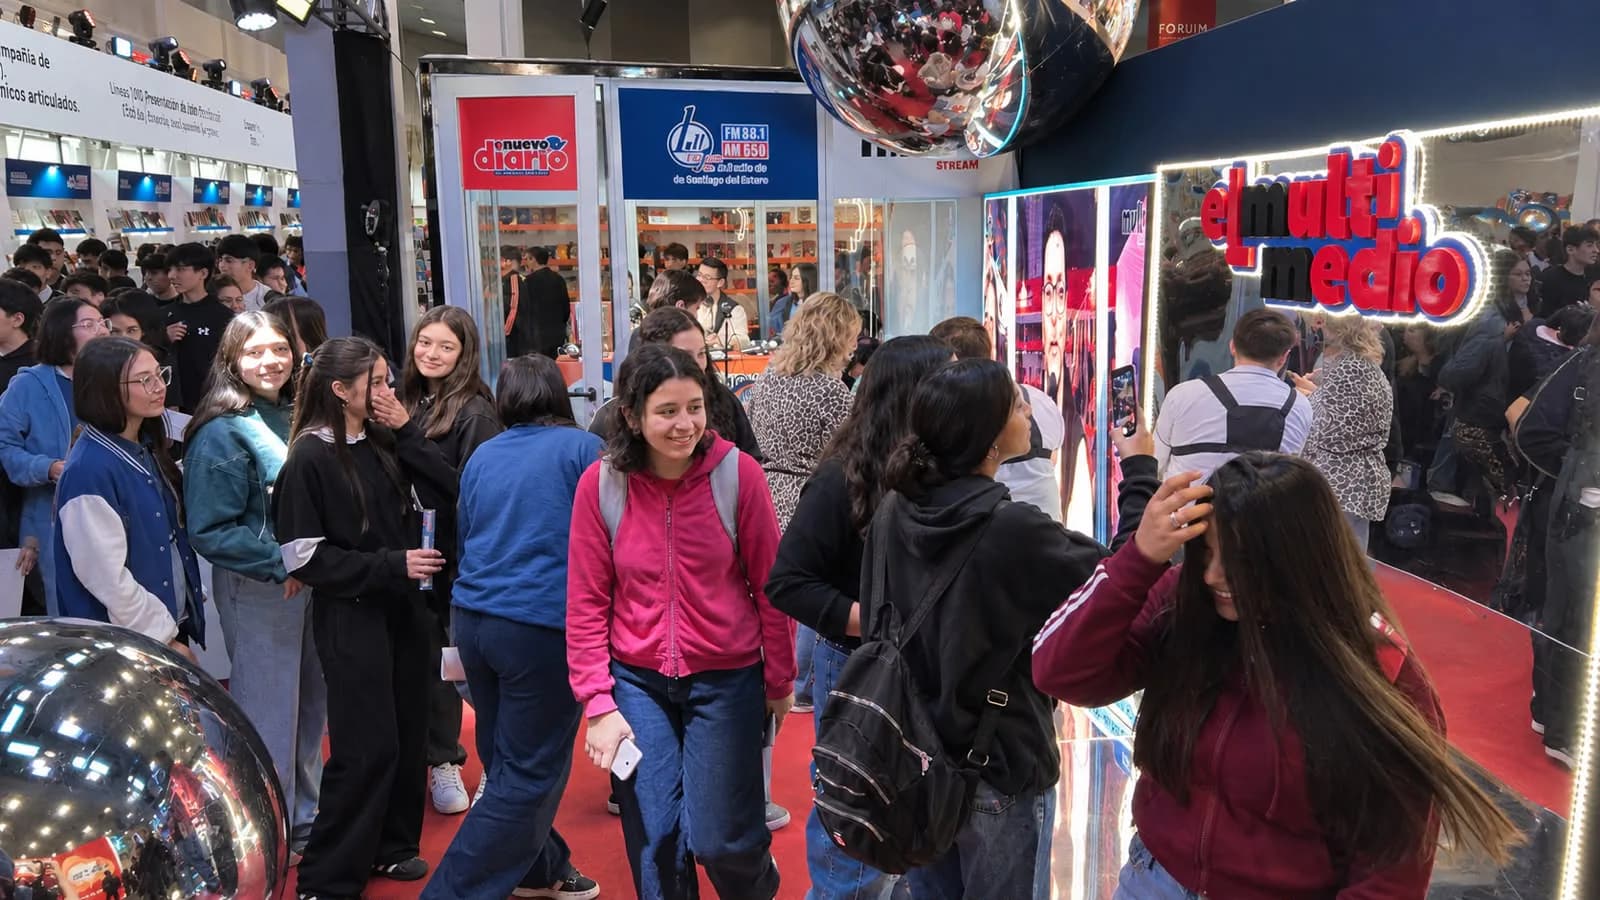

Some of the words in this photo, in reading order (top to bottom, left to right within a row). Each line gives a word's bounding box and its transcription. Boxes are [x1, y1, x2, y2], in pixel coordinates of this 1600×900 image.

[38, 52, 51, 69] de
[28, 90, 81, 113] articulados.
[724, 126, 741, 140] FM
[742, 127, 765, 140] 88.1
[503, 139, 549, 150] nuevo
[724, 143, 741, 157] AM
[743, 143, 766, 157] 650
[474, 139, 569, 171] diario
[936, 159, 979, 171] STREAM
[1261, 216, 1468, 318] medio
